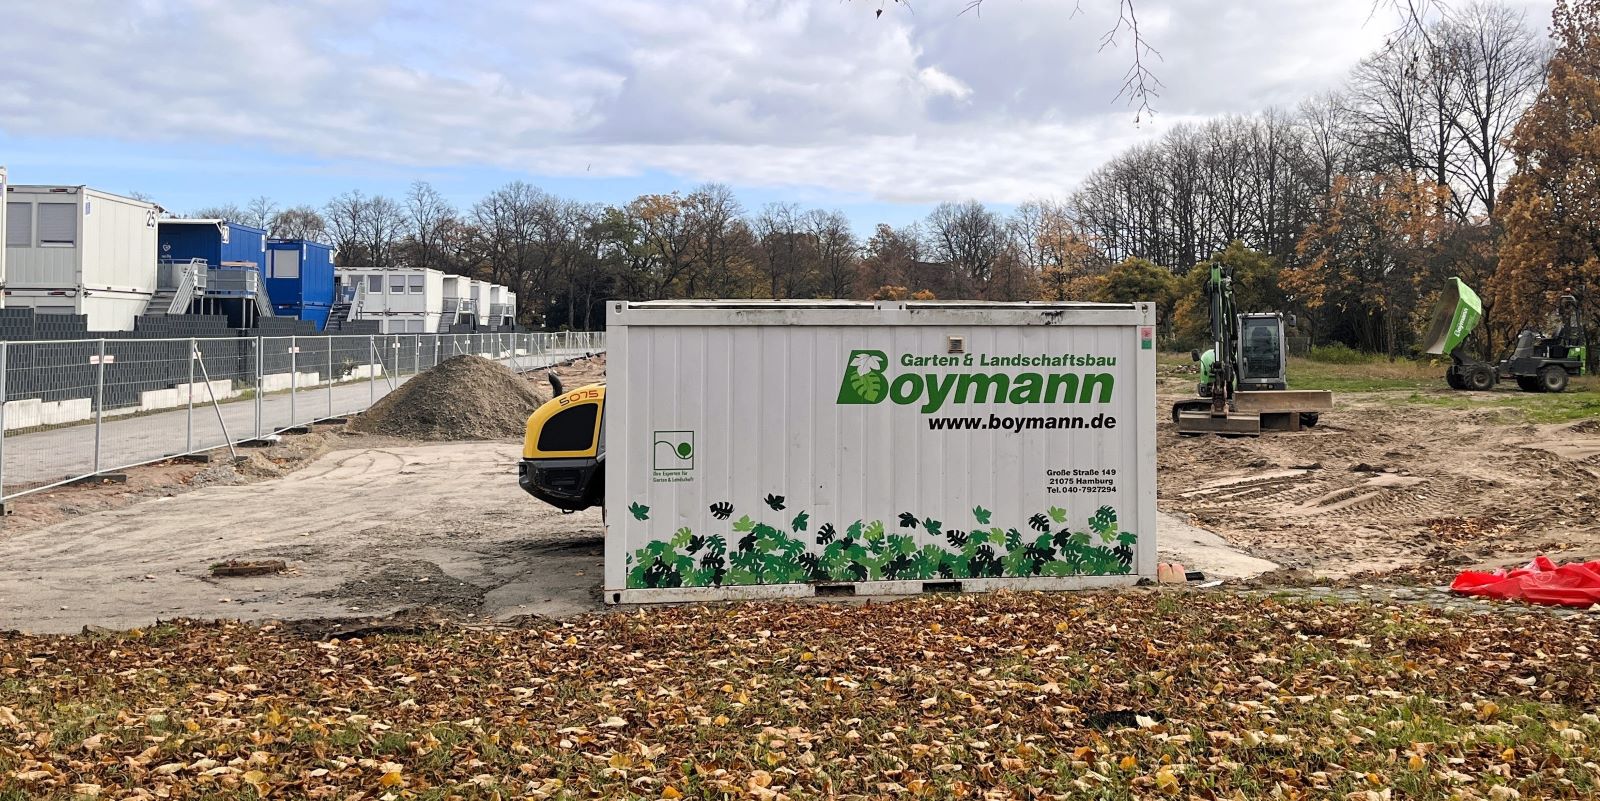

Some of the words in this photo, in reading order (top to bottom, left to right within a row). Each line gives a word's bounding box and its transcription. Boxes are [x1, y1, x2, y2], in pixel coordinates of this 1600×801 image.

[147, 210, 155, 227] 25
[900, 353, 960, 367] Garten
[963, 353, 974, 367] &
[980, 353, 1117, 367] Landschaftsbau
[836, 350, 1115, 413] Boymann
[559, 389, 599, 407] 5075
[928, 413, 1117, 433] www.boymann.de
[1073, 468, 1099, 476] Straße
[1101, 468, 1117, 476] 149
[1075, 478, 1114, 486] Hamburg
